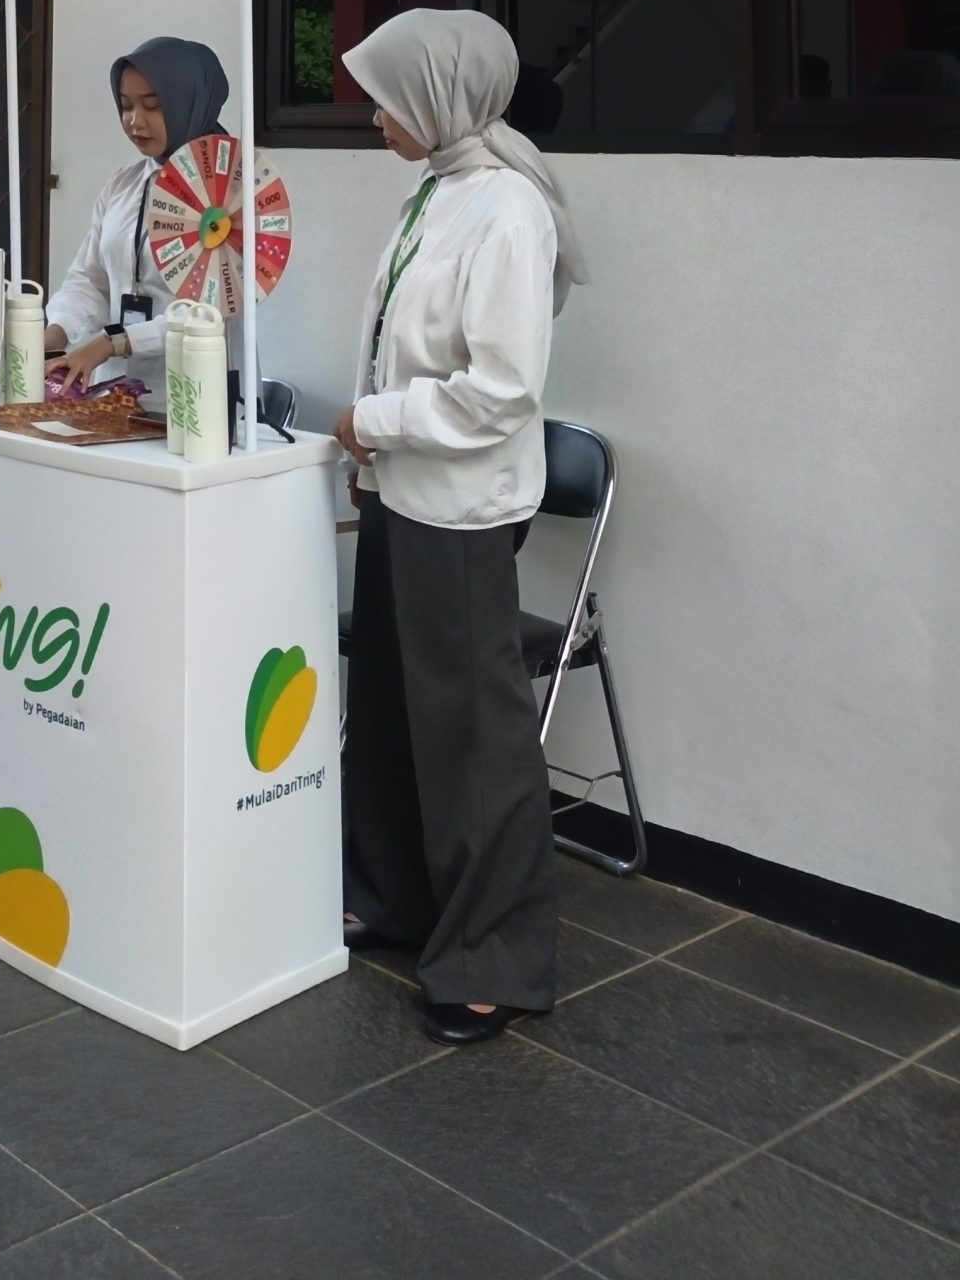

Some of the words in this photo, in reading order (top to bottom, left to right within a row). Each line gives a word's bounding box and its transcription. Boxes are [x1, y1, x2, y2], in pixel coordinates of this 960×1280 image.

[202, 148, 213, 180] ZONK
[160, 221, 185, 232] ZONK
[221, 261, 236, 314] TUMBLER
[23, 697, 34, 716] by
[36, 703, 85, 732] Pegadaian
[236, 766, 326, 812] #MulaiDariTring!
